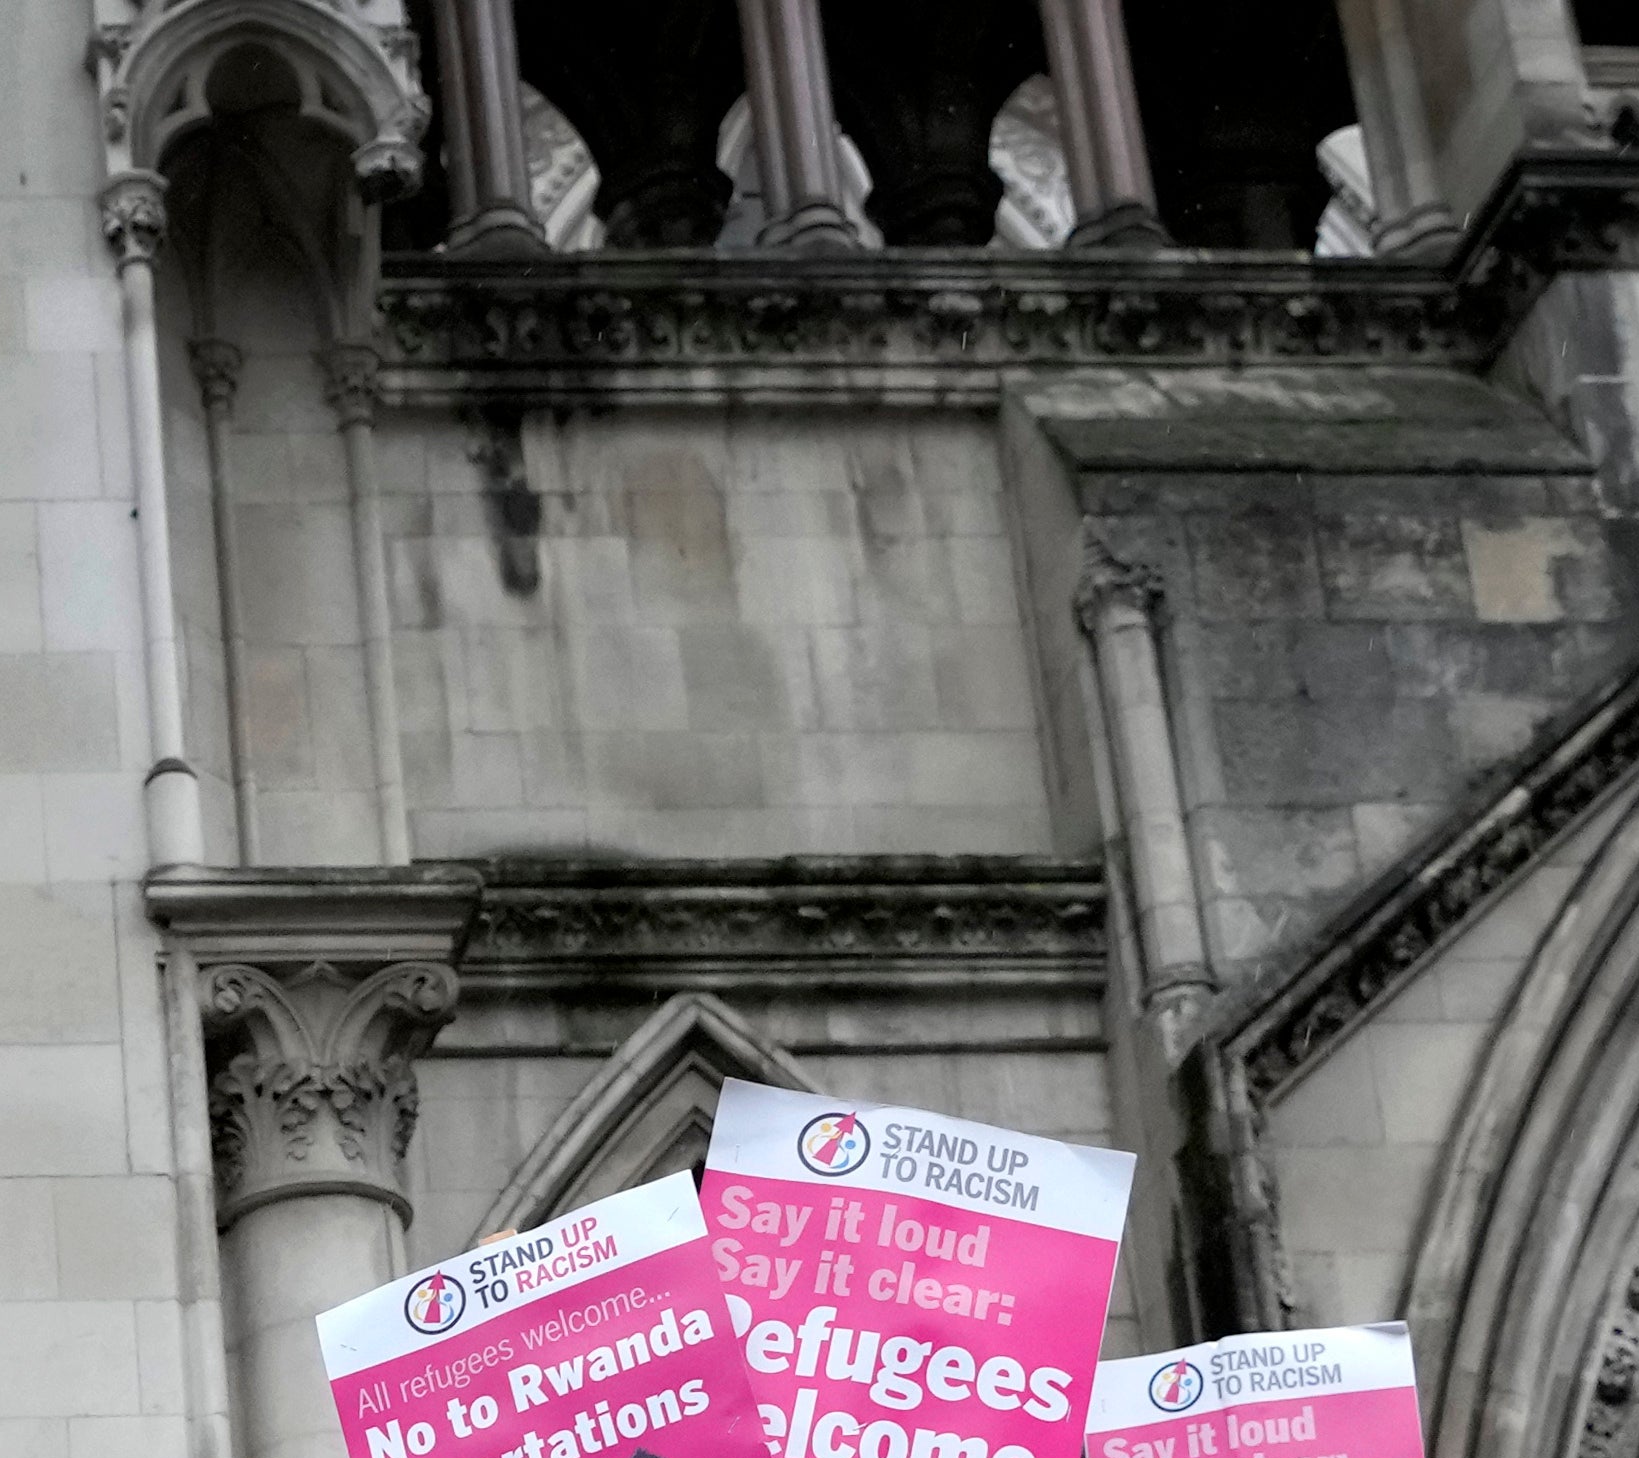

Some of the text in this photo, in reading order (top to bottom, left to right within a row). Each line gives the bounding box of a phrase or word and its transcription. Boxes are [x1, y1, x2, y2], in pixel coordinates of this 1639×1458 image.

[467, 1217, 599, 1283] STAND UP
[715, 1184, 991, 1268] Say it loud
[473, 1234, 620, 1308] TO RACISM
[814, 1251, 854, 1296] it
[360, 1382, 390, 1418] All
[399, 1334, 516, 1407] refugees
[447, 1396, 498, 1438] to
[508, 1305, 714, 1411] Rwanda
